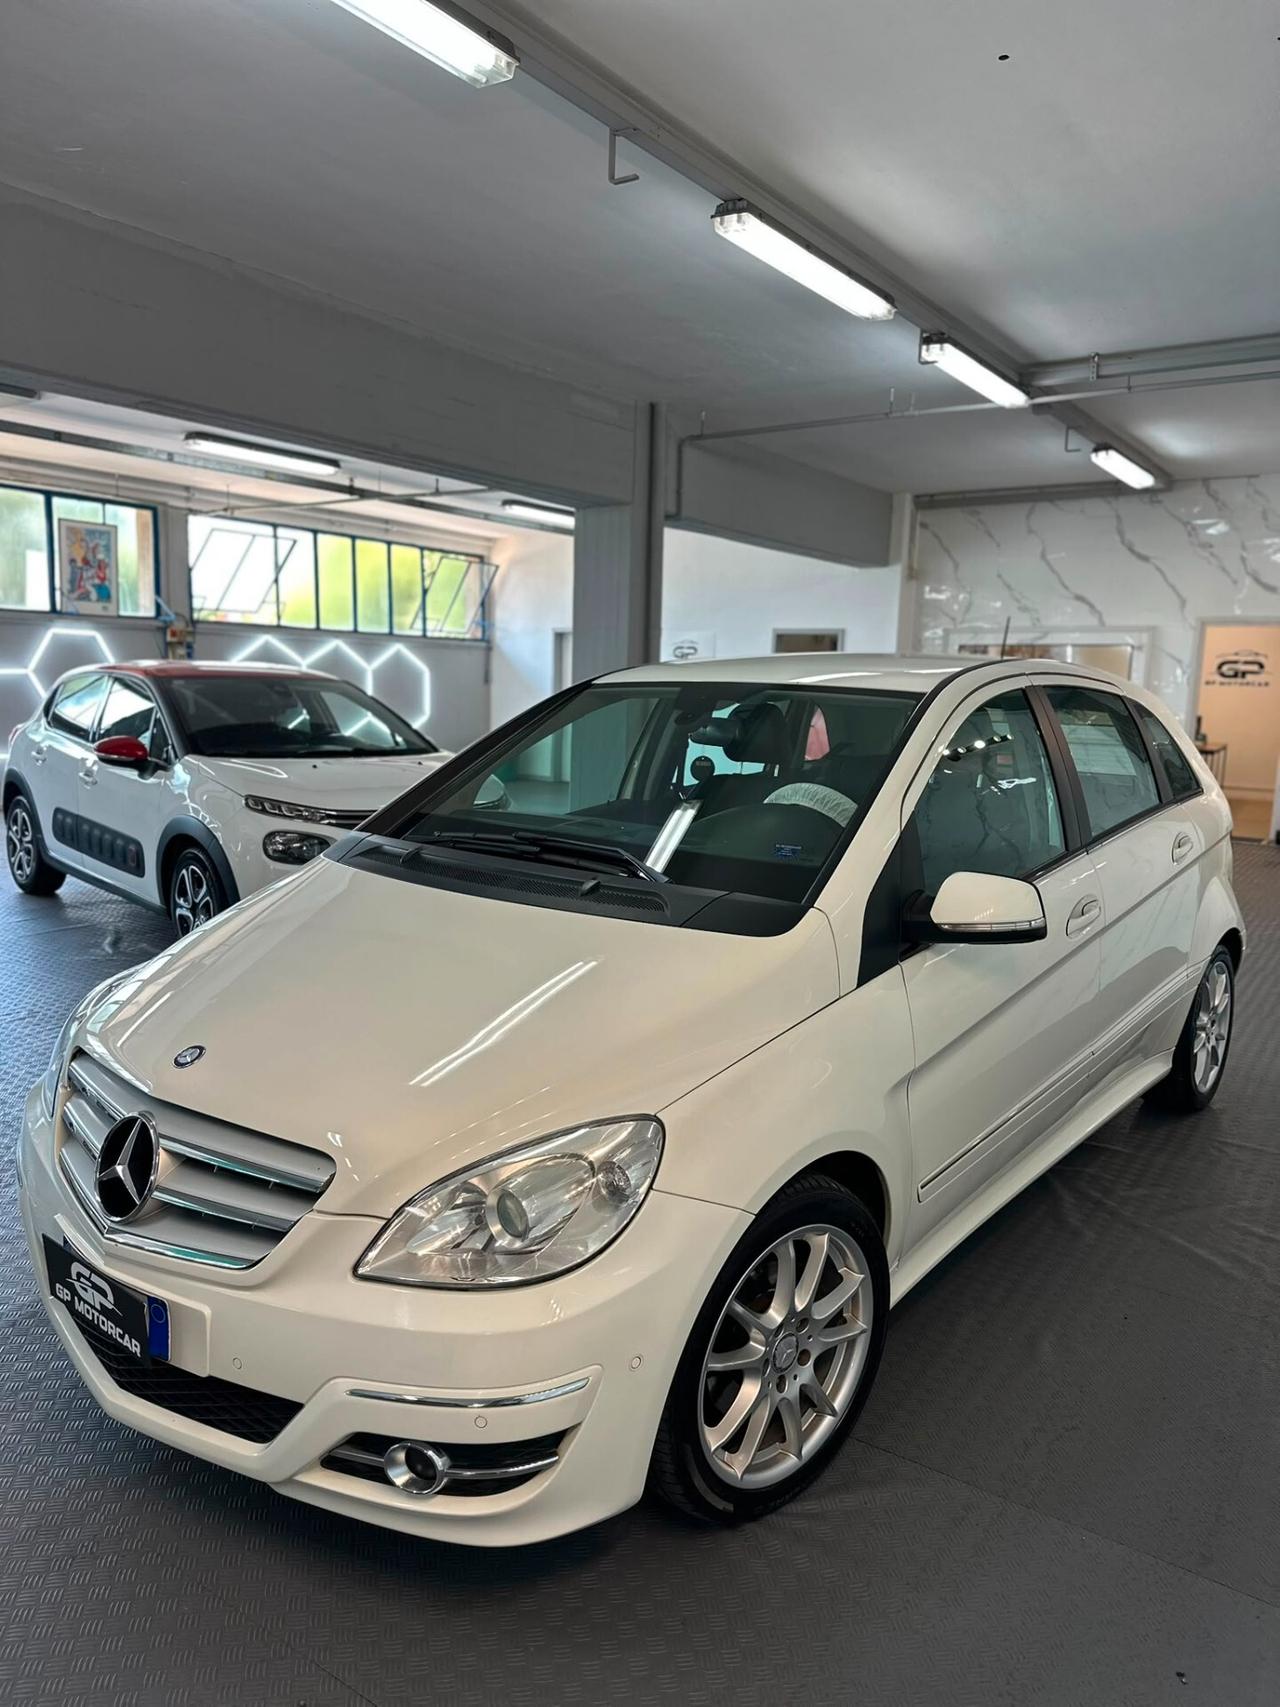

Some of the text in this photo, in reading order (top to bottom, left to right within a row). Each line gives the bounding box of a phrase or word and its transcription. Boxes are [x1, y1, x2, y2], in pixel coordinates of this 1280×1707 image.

[1217, 660, 1265, 679] GP
[70, 1261, 115, 1311] GP
[55, 1282, 141, 1358] GP MOTORCAR
